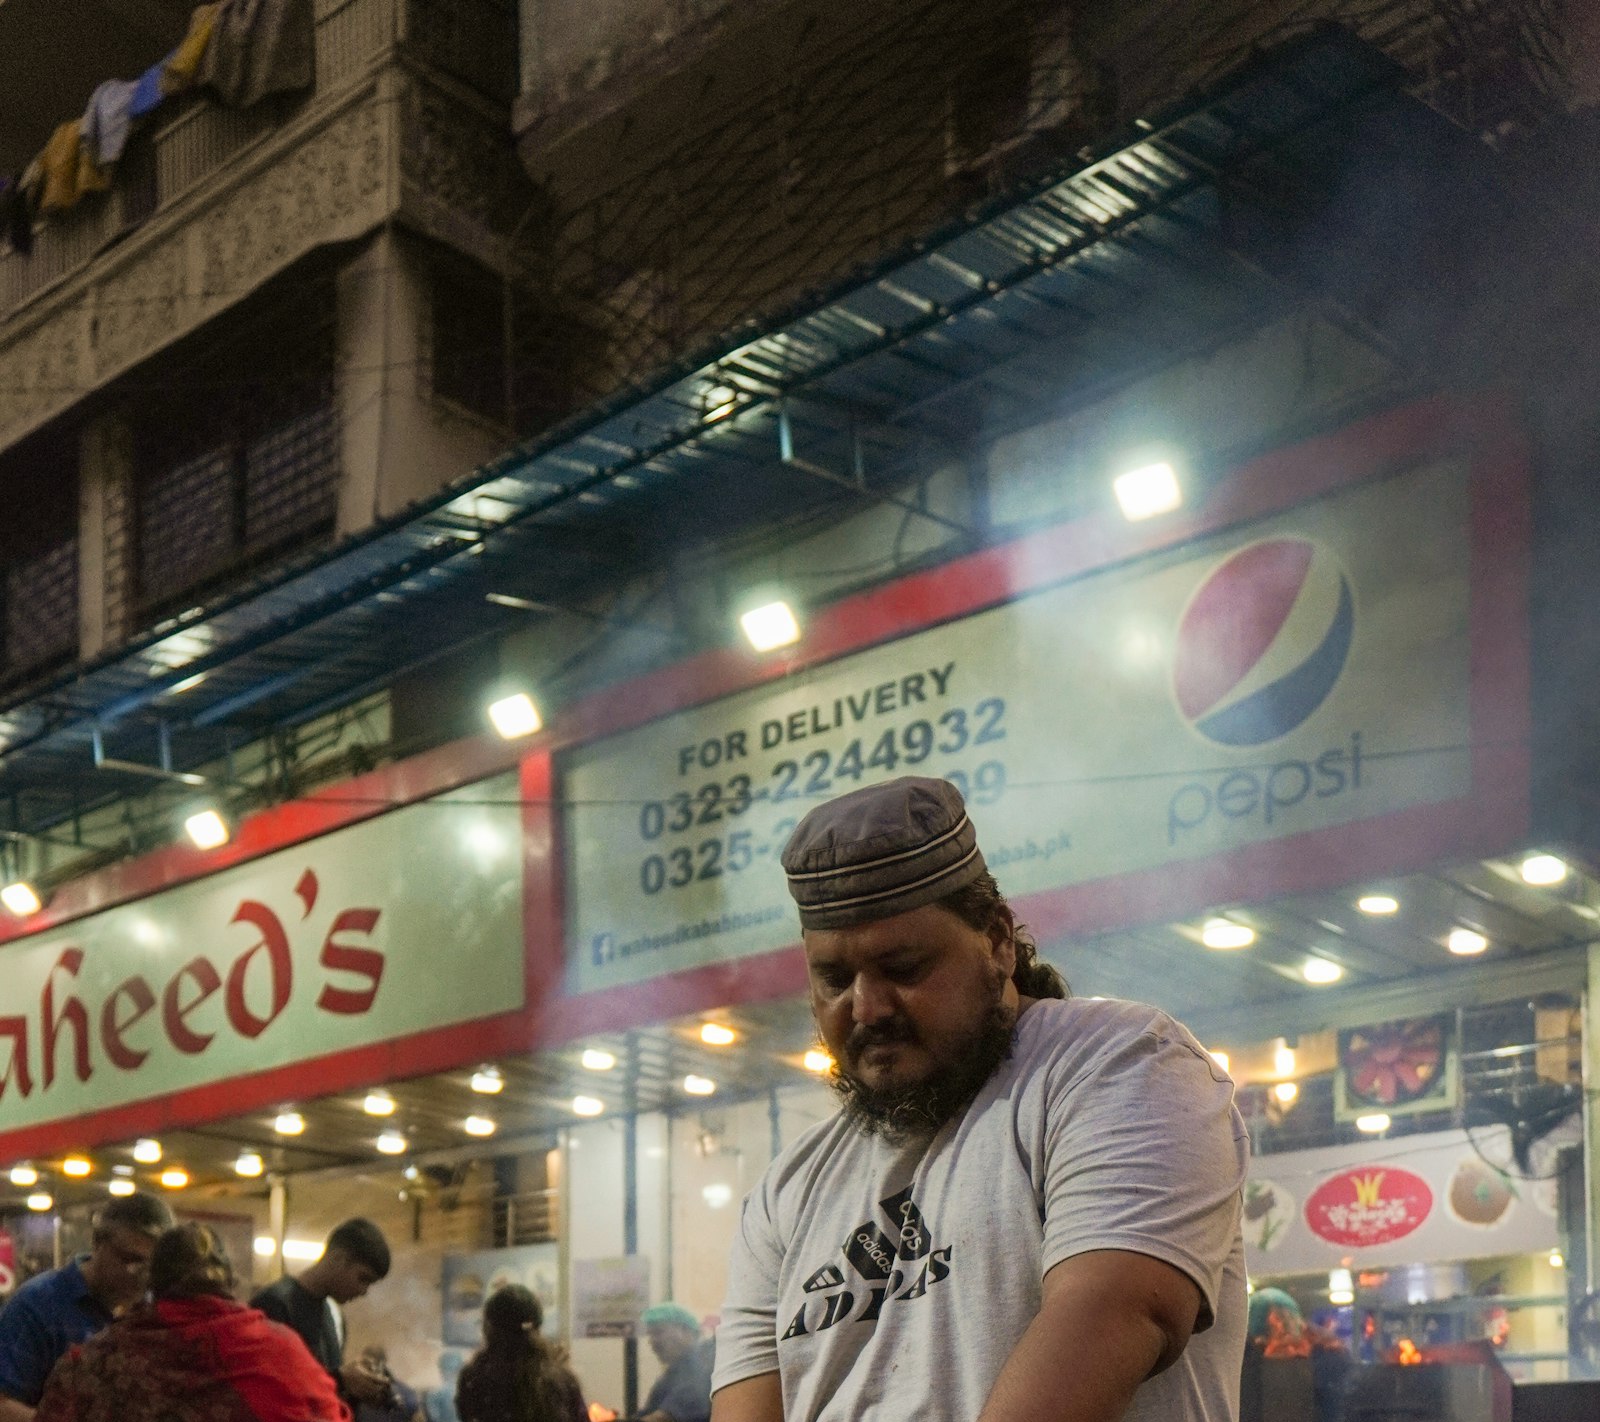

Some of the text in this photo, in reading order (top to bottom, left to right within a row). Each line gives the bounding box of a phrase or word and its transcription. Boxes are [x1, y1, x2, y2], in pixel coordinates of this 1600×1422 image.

[638, 697, 1008, 842] 0323-2244932
[678, 661, 956, 776] FOR DELIVERY
[1168, 731, 1363, 847] pepsi
[856, 1232, 893, 1275] adidas
